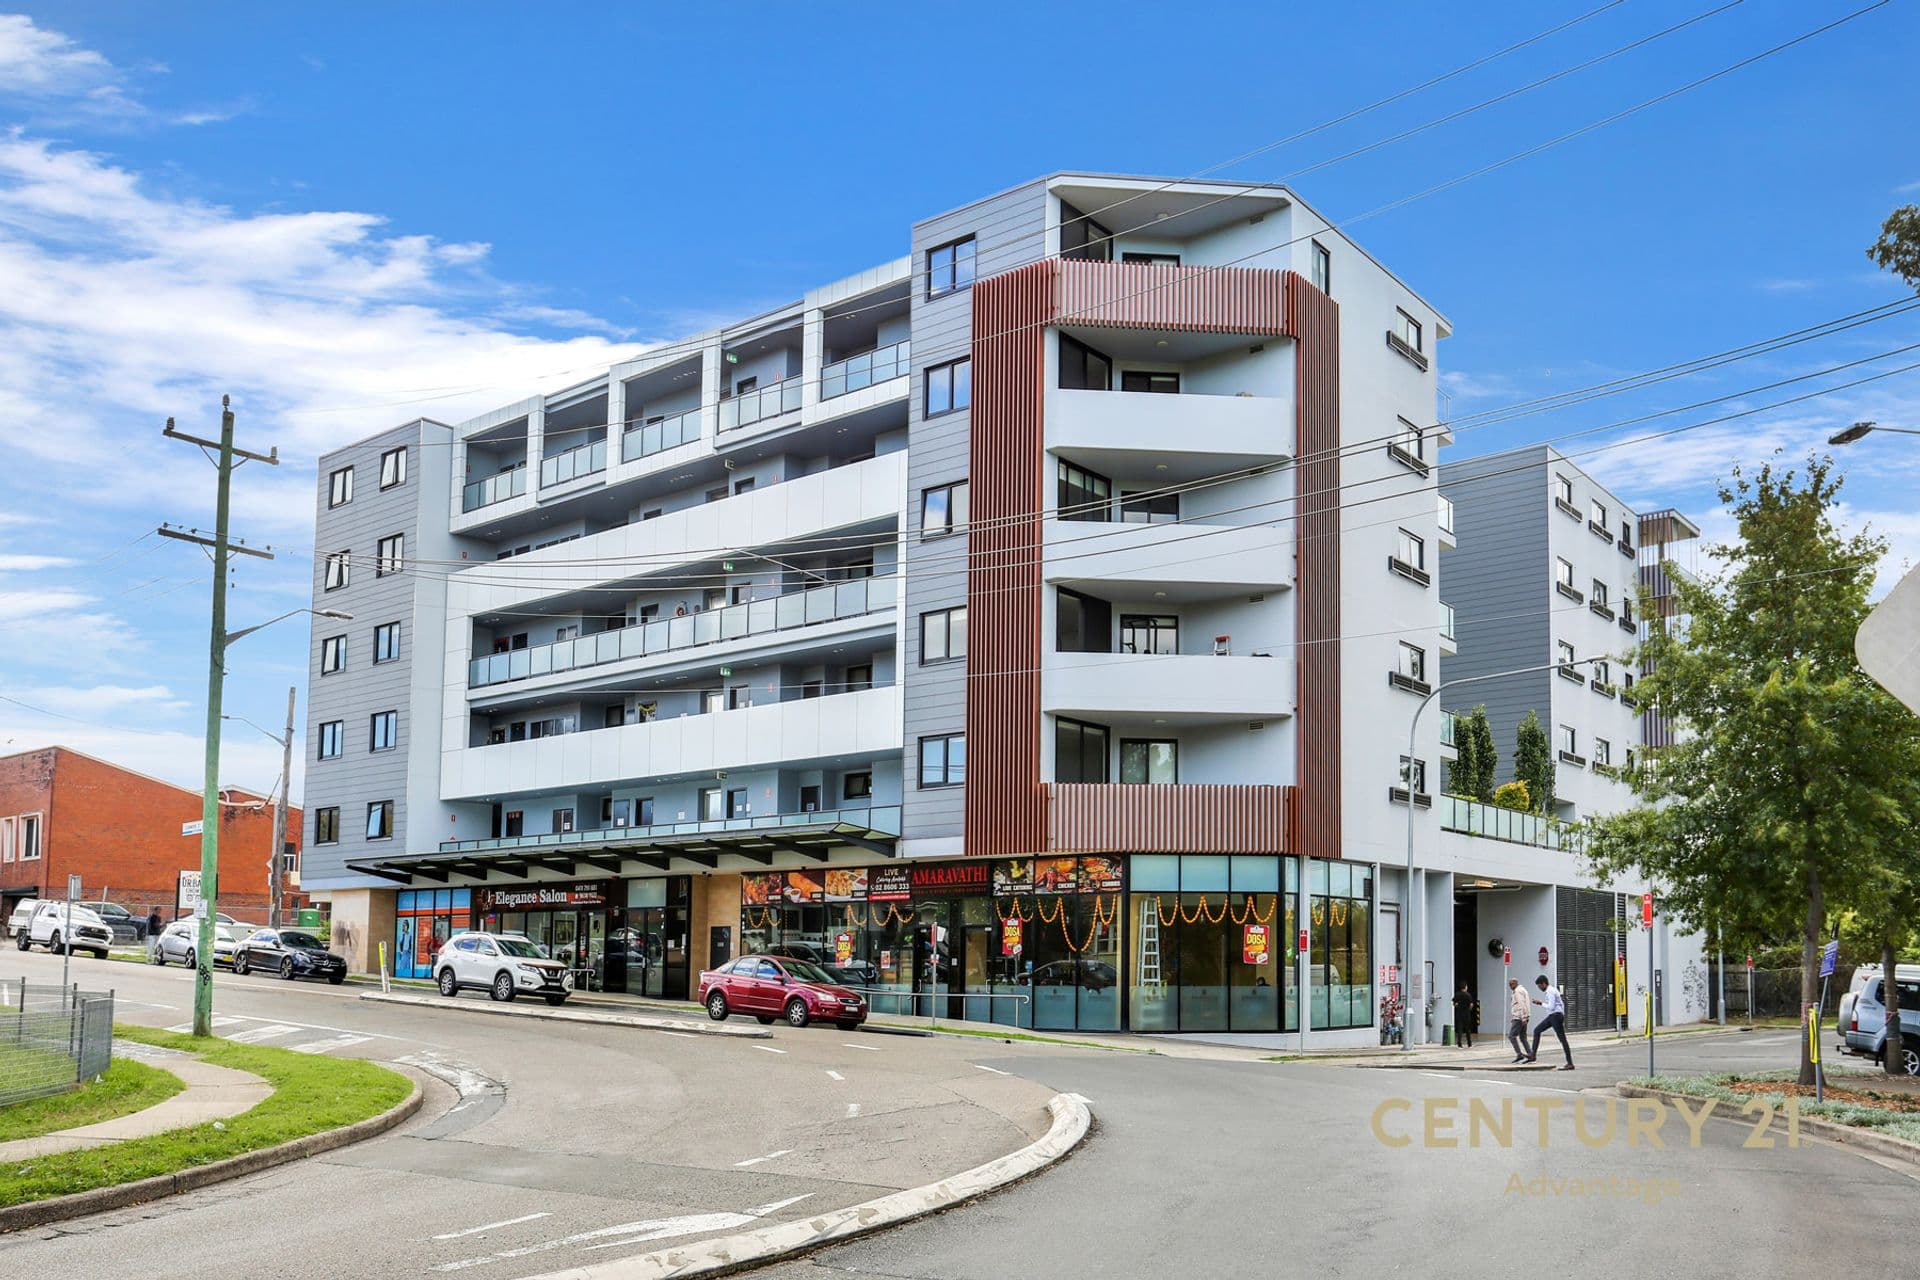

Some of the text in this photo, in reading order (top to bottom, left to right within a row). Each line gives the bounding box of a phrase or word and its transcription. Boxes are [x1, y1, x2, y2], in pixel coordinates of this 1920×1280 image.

[884, 868, 899, 876] LIVE
[912, 864, 988, 884] AMARAVATHI
[495, 891, 537, 908] Elegance
[540, 888, 568, 903] Salon
[1004, 926, 1021, 937] DOSA
[1246, 934, 1267, 945] DOSA
[837, 941, 851, 951] DOSA
